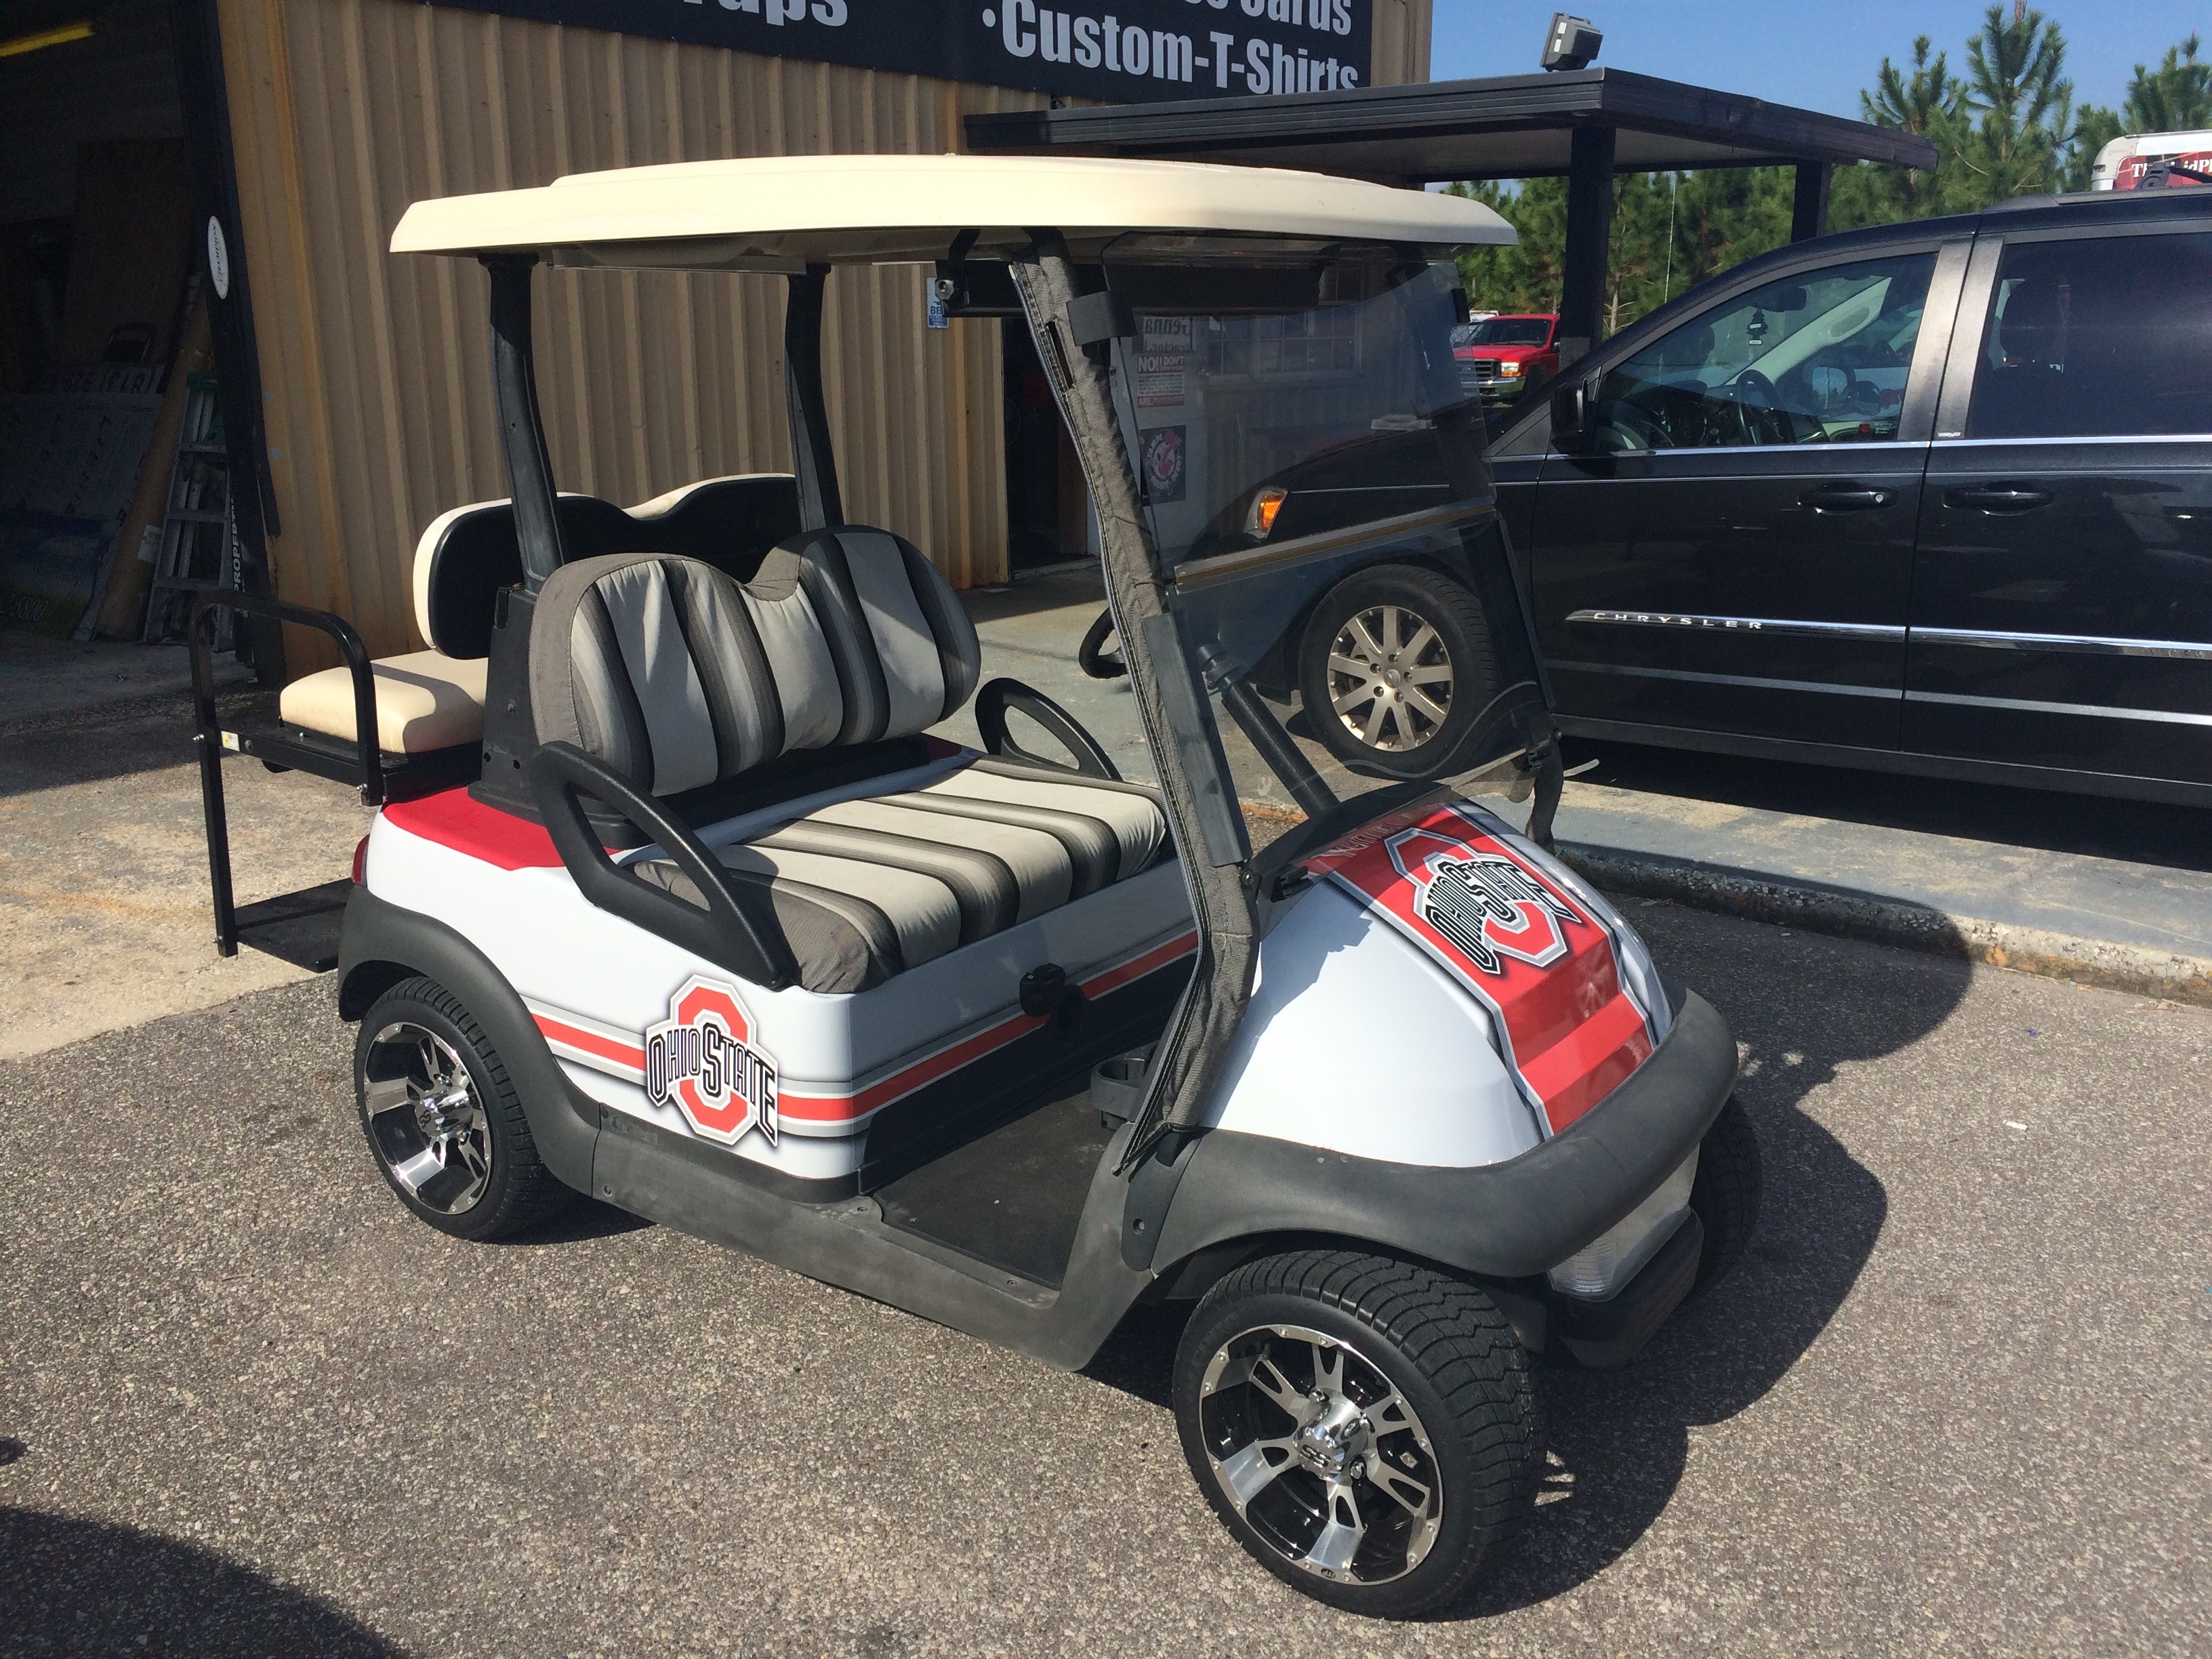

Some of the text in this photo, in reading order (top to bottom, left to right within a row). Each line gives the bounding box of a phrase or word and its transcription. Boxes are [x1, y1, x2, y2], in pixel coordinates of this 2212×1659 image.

[1139, 356, 1159, 371] NO!
[1164, 356, 1184, 365] DON'T
[1593, 611, 1763, 630] CHRYSLER
[1425, 860, 1582, 975] OHIO STATE
[648, 1021, 777, 1145] OHIO STATE
